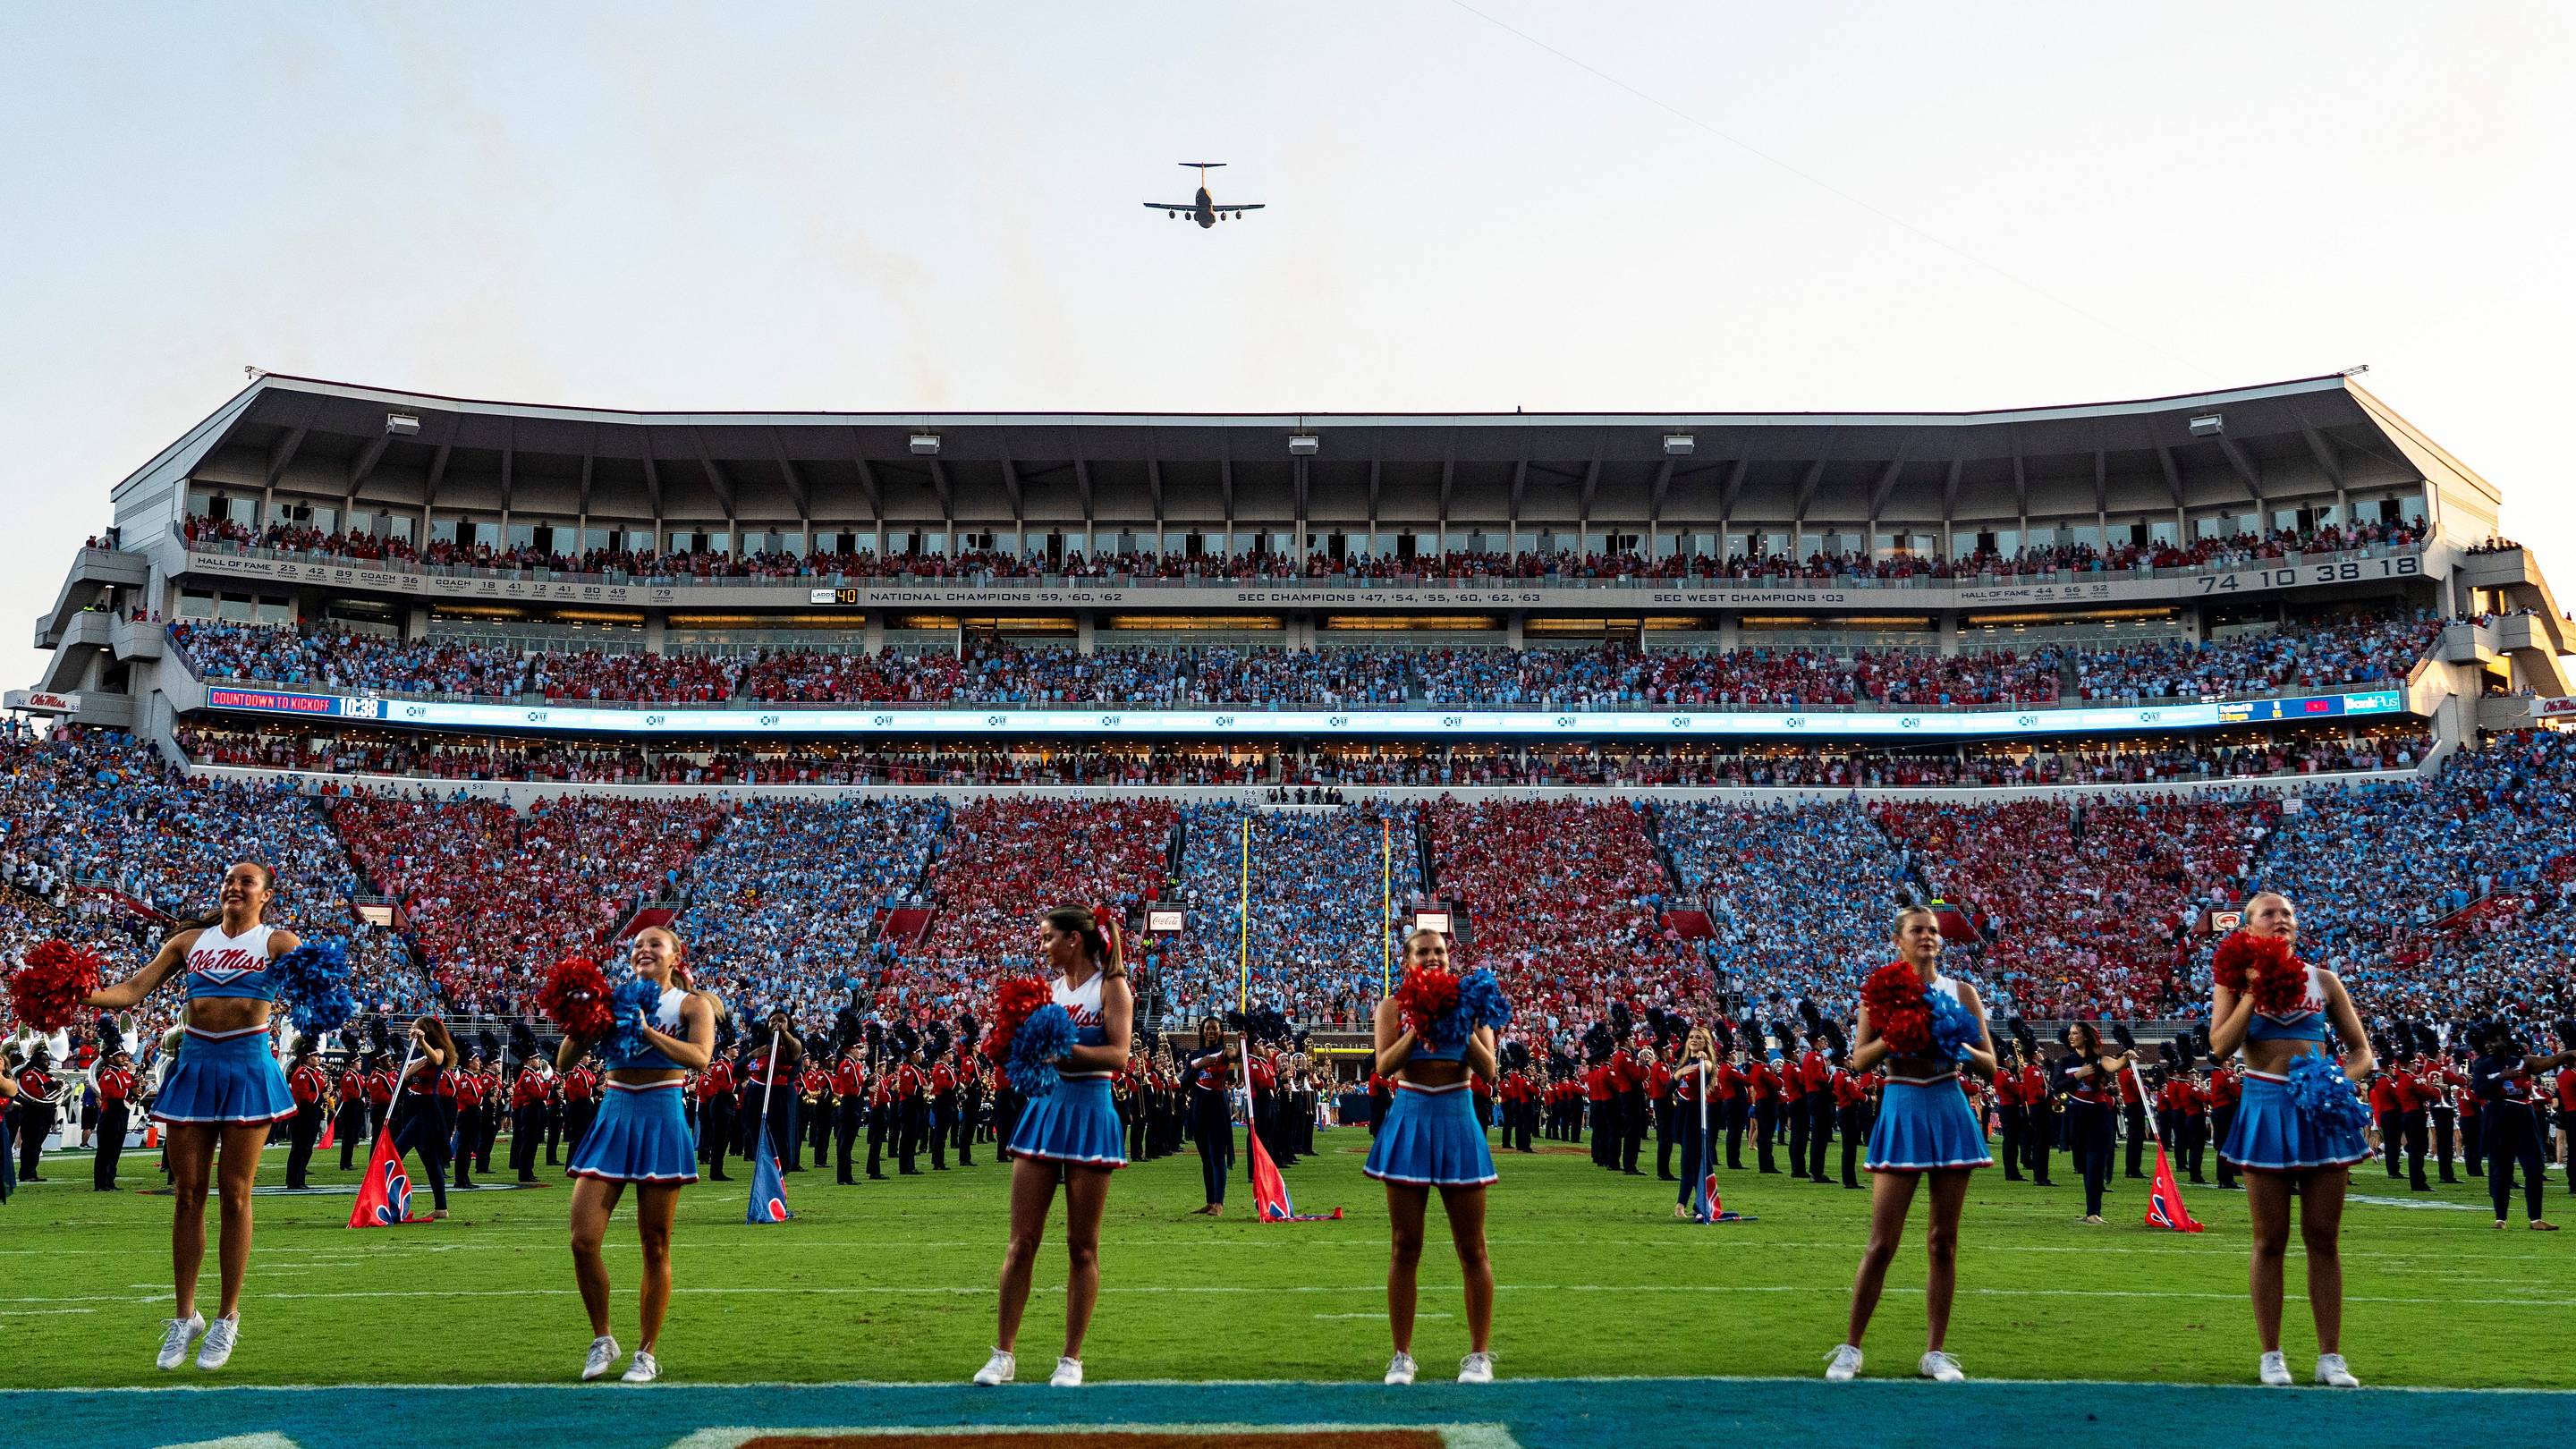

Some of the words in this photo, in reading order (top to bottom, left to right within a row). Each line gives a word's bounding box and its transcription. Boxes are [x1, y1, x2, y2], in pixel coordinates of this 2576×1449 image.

[198, 557, 225, 566] HALL
[244, 562, 271, 571] FAME
[280, 564, 296, 572] 25
[360, 572, 396, 580] COACH
[402, 576, 419, 584] 36
[2199, 574, 2239, 593] 74
[2260, 569, 2296, 587] 10
[2317, 563, 2360, 581] 38
[2380, 556, 2417, 576] 18
[837, 589, 856, 603] 40
[870, 593, 941, 601] NATIONAL
[946, 593, 1031, 601] CHAMPIONS
[1237, 594, 1265, 602] SEC
[1271, 594, 1355, 602] CHAMPIONS
[1654, 594, 1681, 602] SEC
[1687, 594, 1725, 602] WEST
[1732, 594, 1816, 602] CHAMPIONS
[30, 694, 45, 706] Ole
[45, 695, 66, 708] Miss
[213, 692, 275, 708] COUNTDOWN
[277, 697, 288, 709] TO
[291, 697, 330, 712] KICKOFF
[339, 698, 379, 717] 10:38
[2345, 695, 2397, 709] BankPlus
[188, 948, 216, 973] Ole
[215, 948, 267, 972] Miss
[461, 1002, 465, 1010] 3
